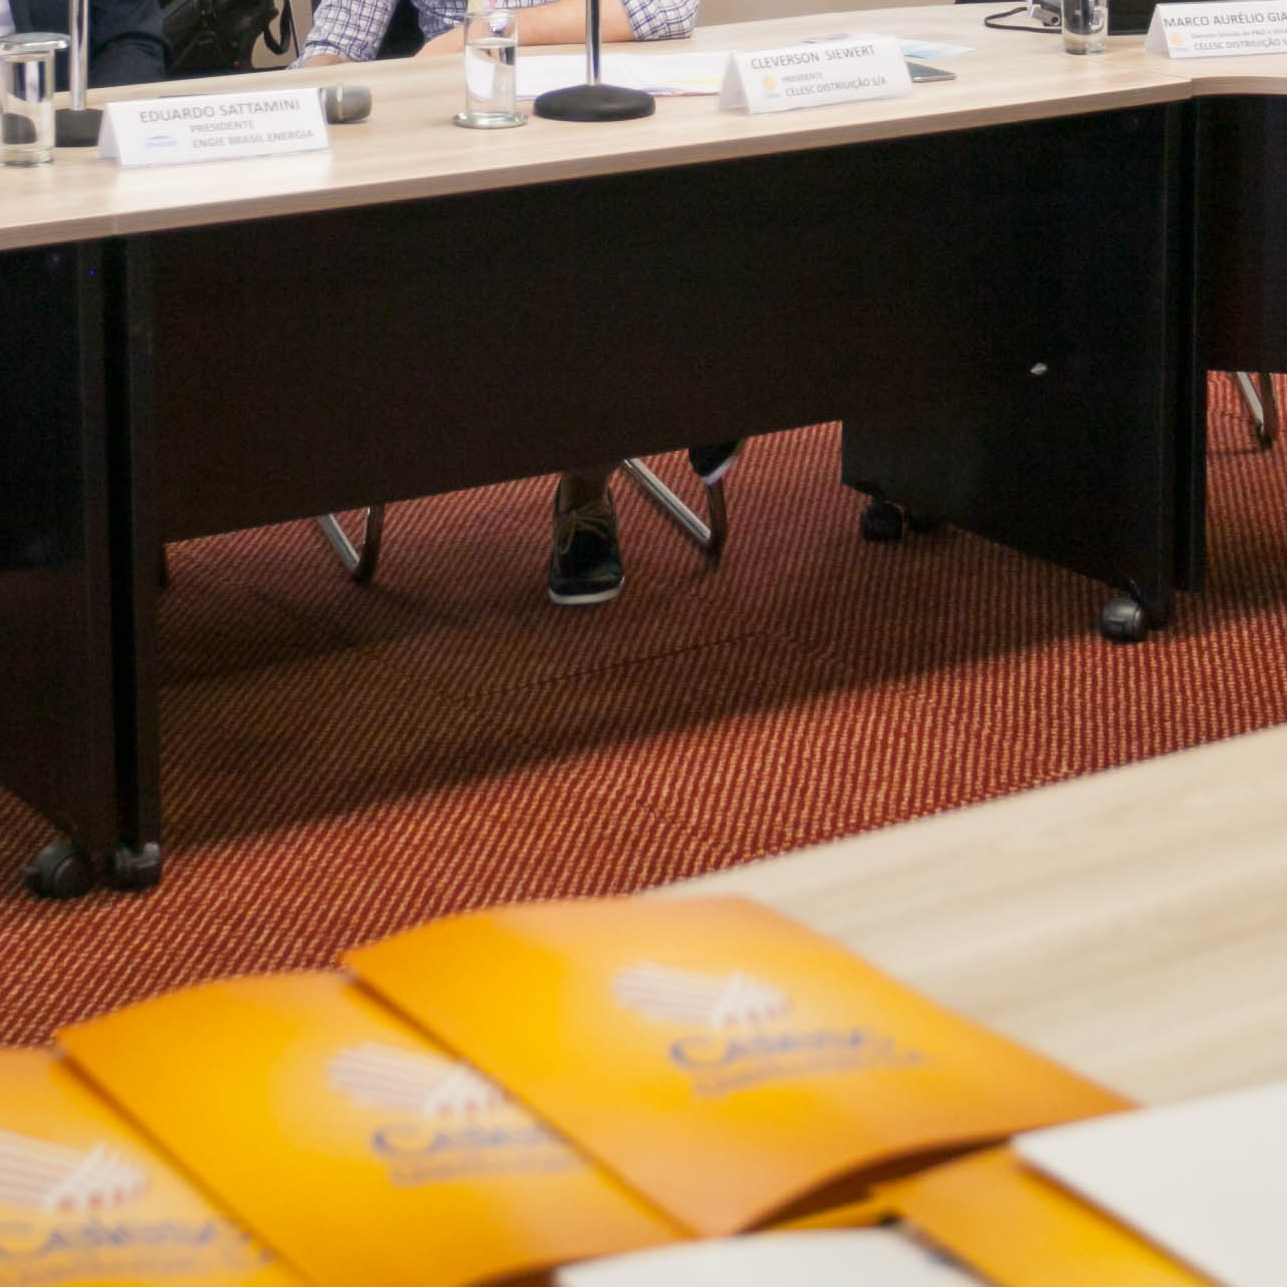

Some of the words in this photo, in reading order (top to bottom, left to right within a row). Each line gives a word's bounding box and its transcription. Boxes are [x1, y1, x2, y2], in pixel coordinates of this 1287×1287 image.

[1163, 16, 1209, 28] MARCO
[1213, 11, 1264, 25] AURÉLIO
[750, 51, 820, 70] CLEVERSON
[825, 44, 876, 61] SIEWERT
[140, 106, 215, 123] EDUARDO
[220, 99, 301, 117] SATTAMINI
[190, 120, 254, 133] PRESIDENTE
[192, 138, 225, 149] ENGIE
[228, 134, 265, 146] BRASIL
[267, 130, 314, 142] ENERGIA
